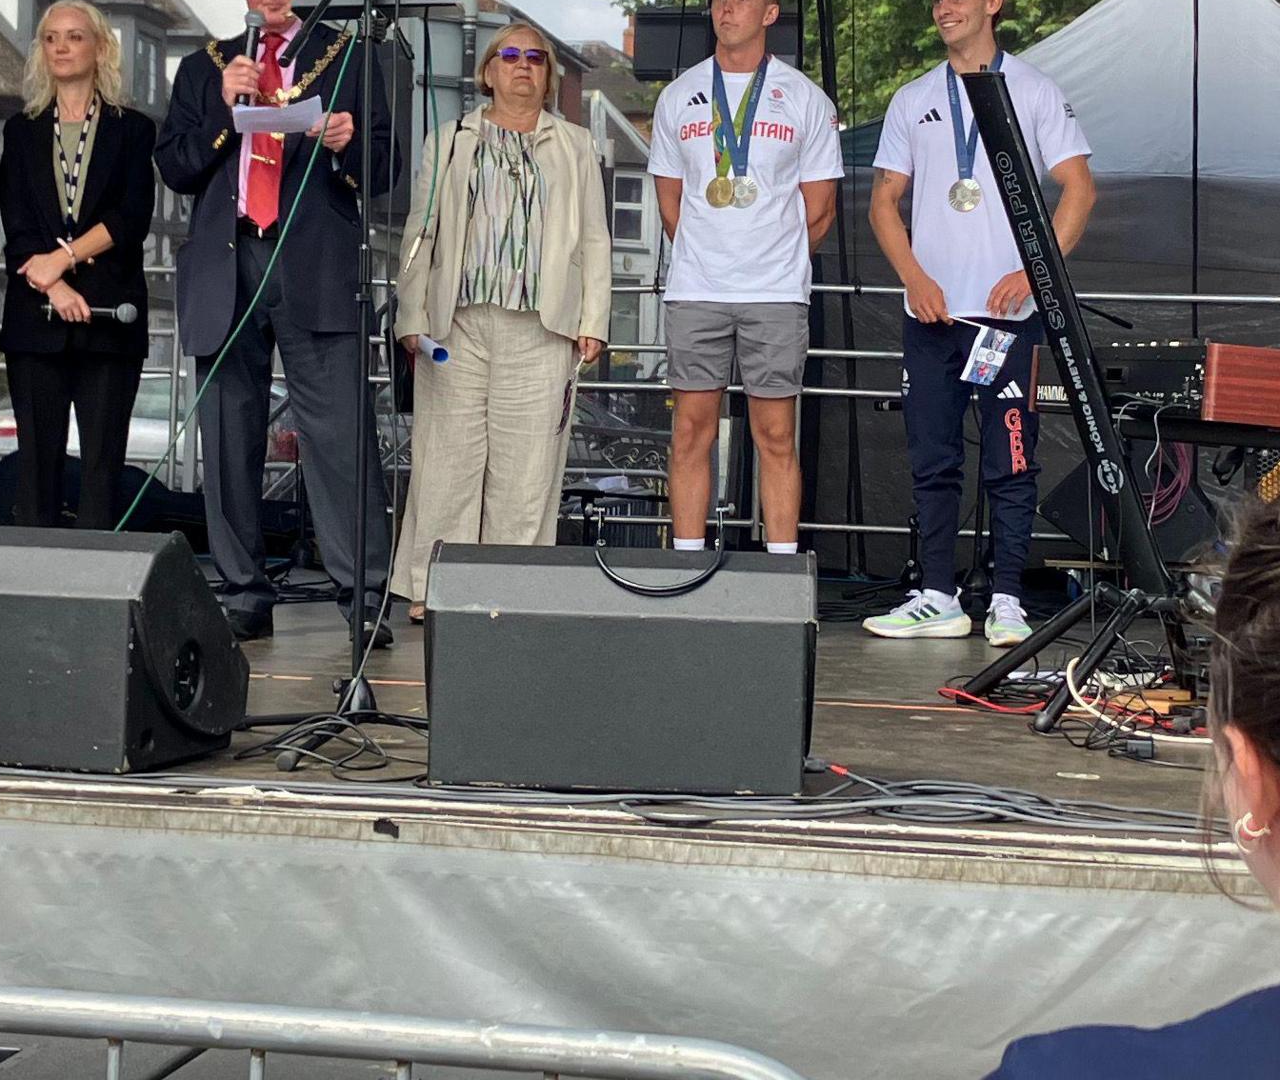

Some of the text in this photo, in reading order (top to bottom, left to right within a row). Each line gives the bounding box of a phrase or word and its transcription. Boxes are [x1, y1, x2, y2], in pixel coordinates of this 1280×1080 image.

[995, 151, 1066, 331] SPIDER PRO
[1059, 336, 1084, 390] MEYER
[1077, 388, 1089, 404] &
[1100, 458, 1120, 495] K&M
